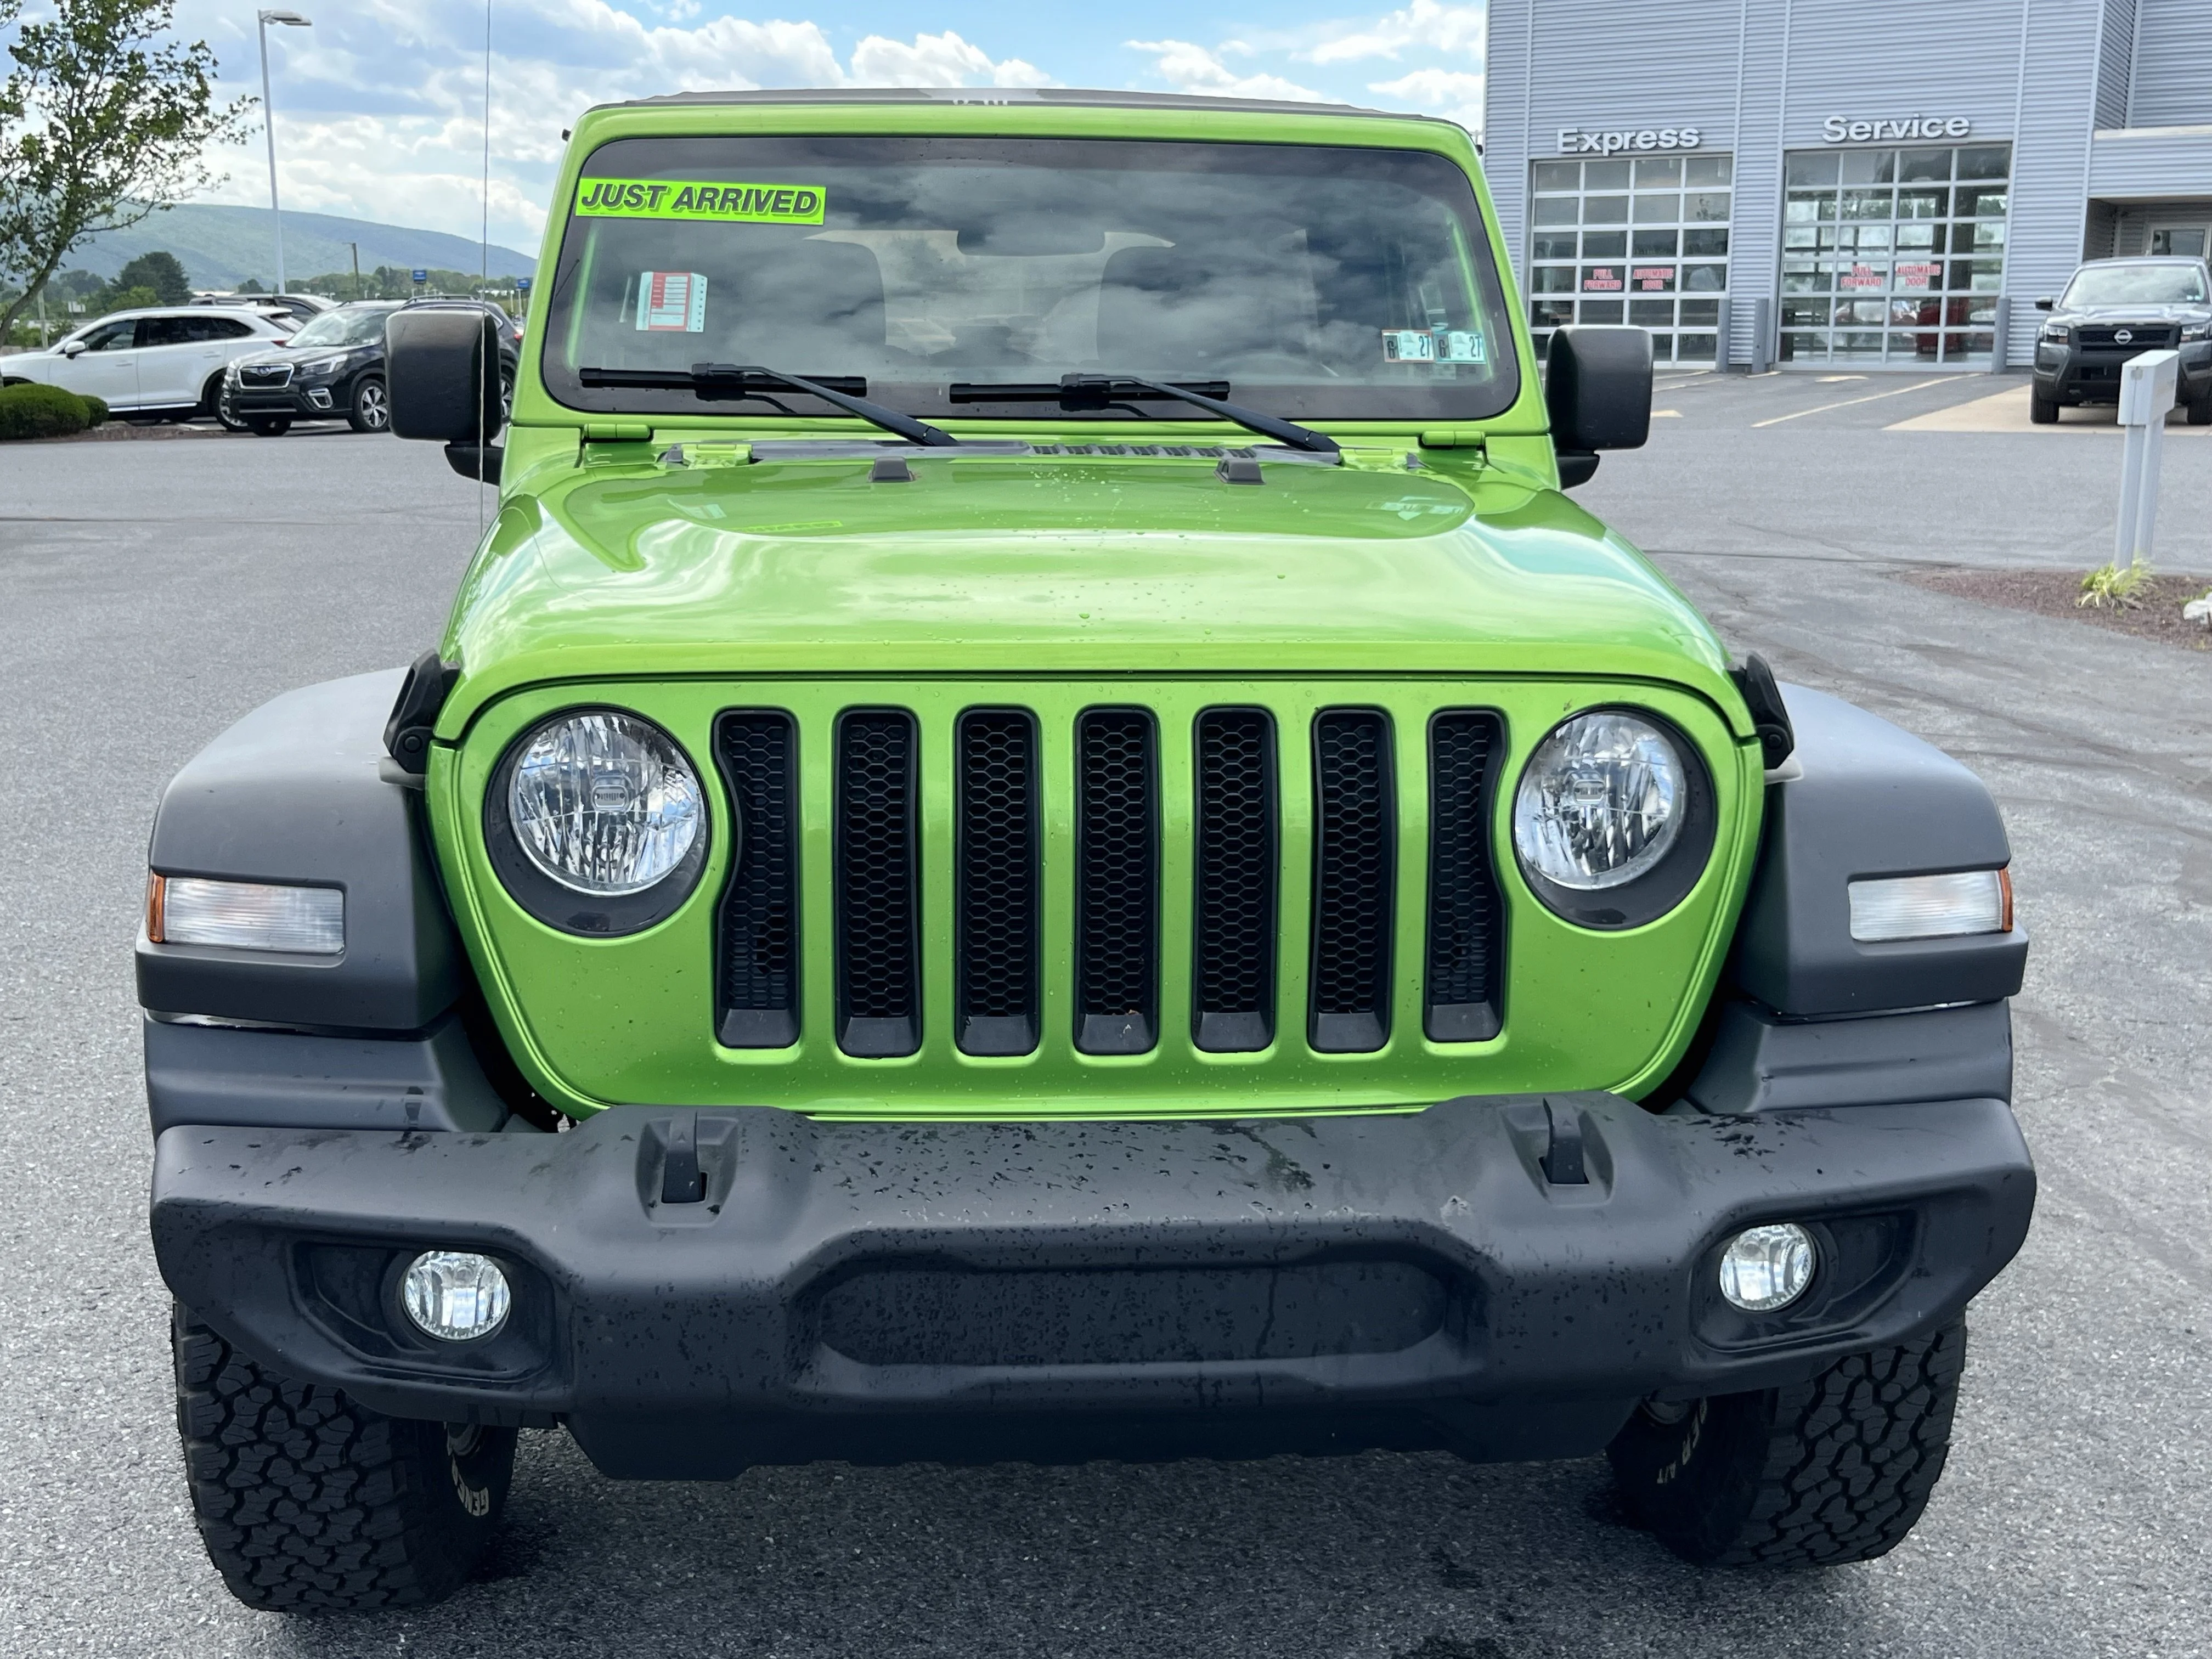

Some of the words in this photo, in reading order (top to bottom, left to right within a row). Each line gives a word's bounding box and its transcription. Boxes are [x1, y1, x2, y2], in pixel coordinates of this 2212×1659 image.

[1822, 113, 1970, 143] Service
[1557, 127, 1700, 157] Express
[582, 184, 672, 212] JUST
[671, 187, 821, 217] ARRIVED
[1593, 268, 1613, 280] PULL
[1633, 268, 1674, 280] AUTOMATIC
[1896, 265, 1941, 275] AUTOMATIC
[1584, 279, 1622, 290] FORWARD
[1642, 279, 1663, 290] DOOR
[1841, 277, 1882, 287] FORWARD
[1905, 276, 1928, 286] DOOR
[1386, 340, 1396, 359] 6
[1419, 335, 1430, 358] 27
[1438, 339, 1447, 358] 6
[1469, 336, 1481, 358] 27
